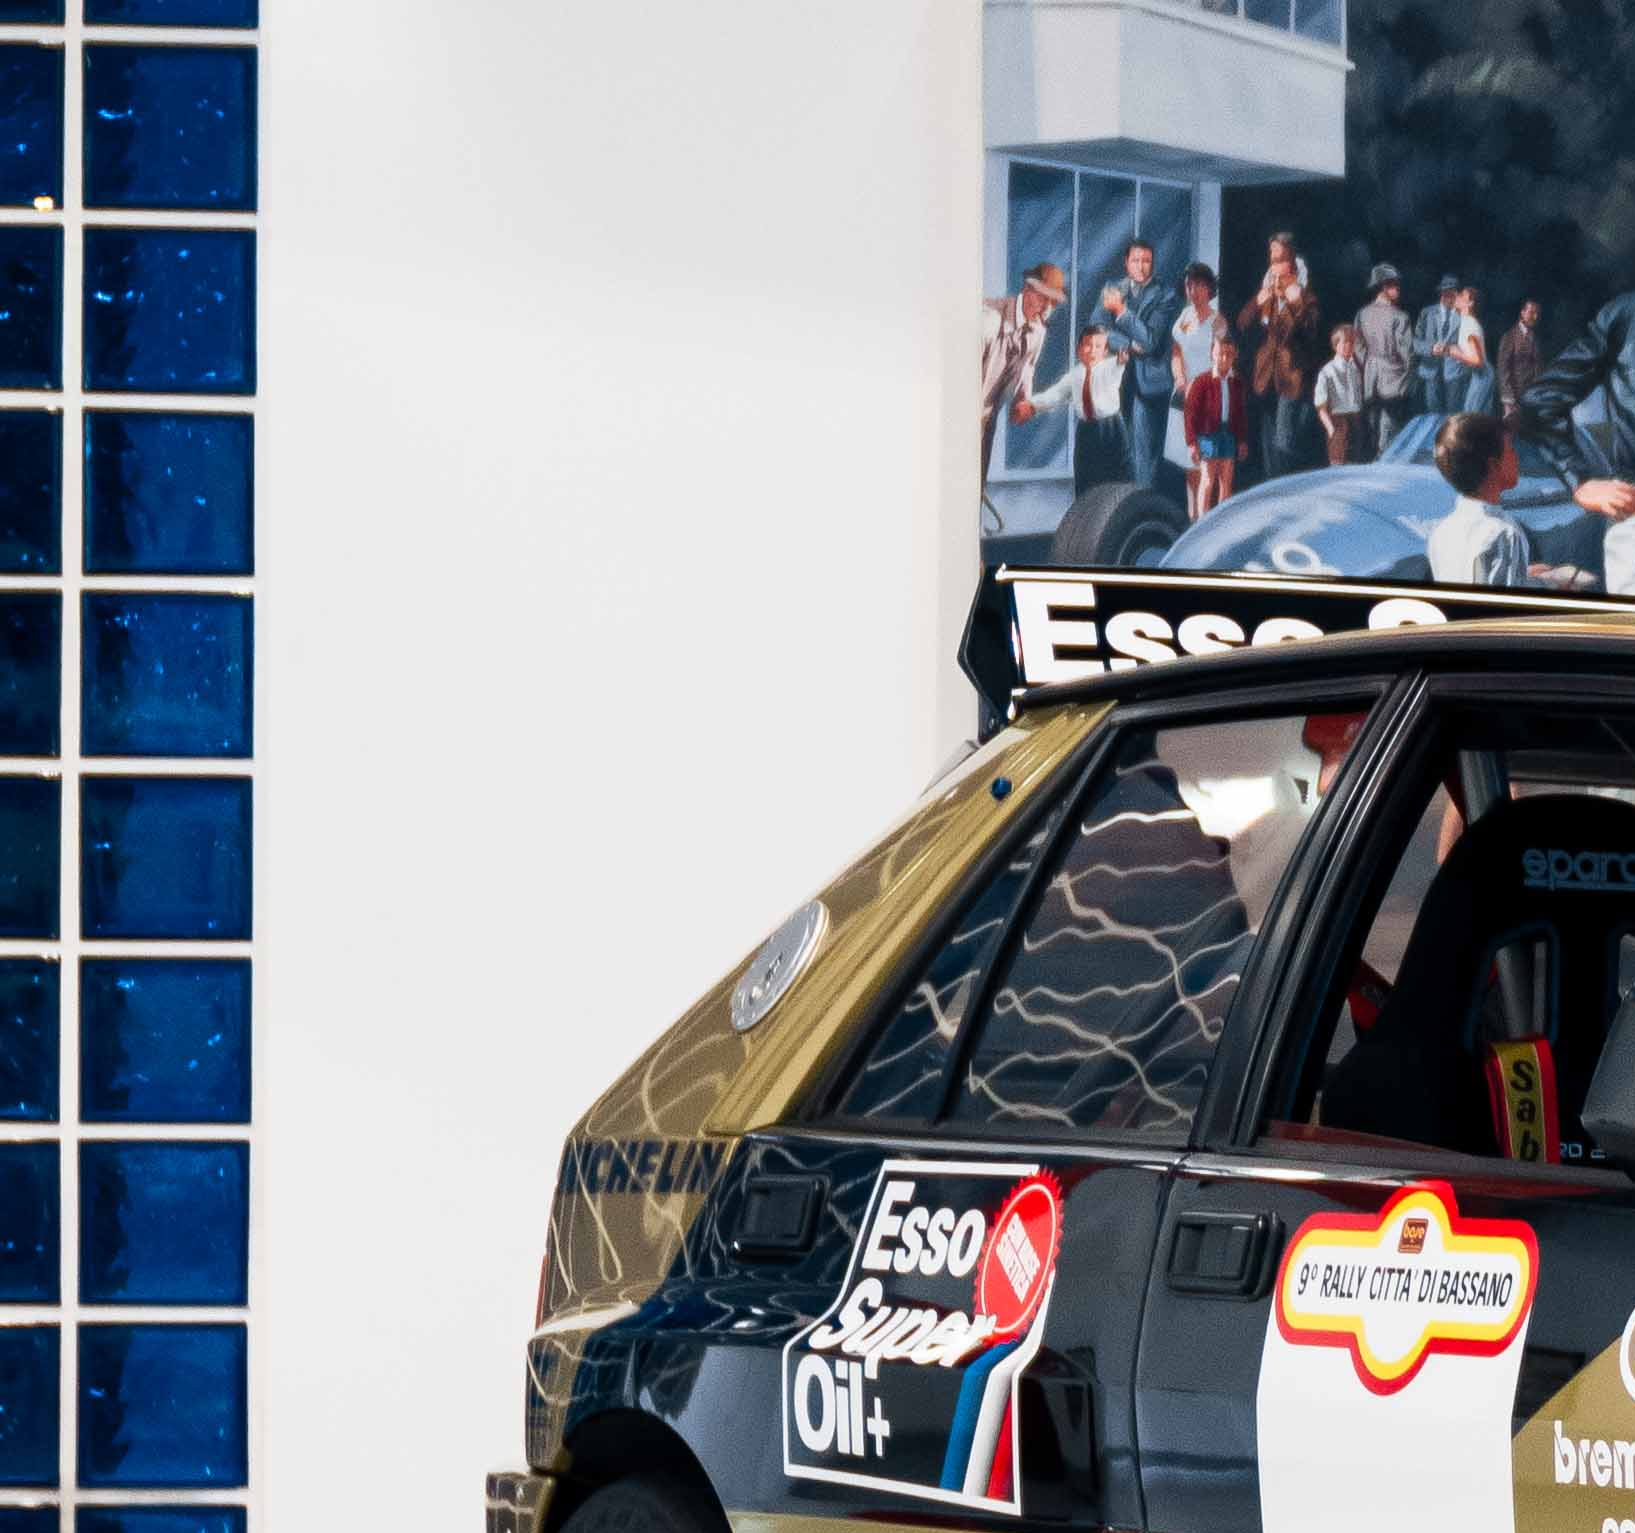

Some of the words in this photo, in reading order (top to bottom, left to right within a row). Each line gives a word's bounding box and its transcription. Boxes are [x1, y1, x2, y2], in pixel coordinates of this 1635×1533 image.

[862, 1181, 985, 1277] Esso
[809, 1277, 997, 1379] Super
[1320, 1264, 1366, 1299] RALLY
[1417, 1269, 1437, 1303] DI
[1437, 1271, 1513, 1307] BASSANO
